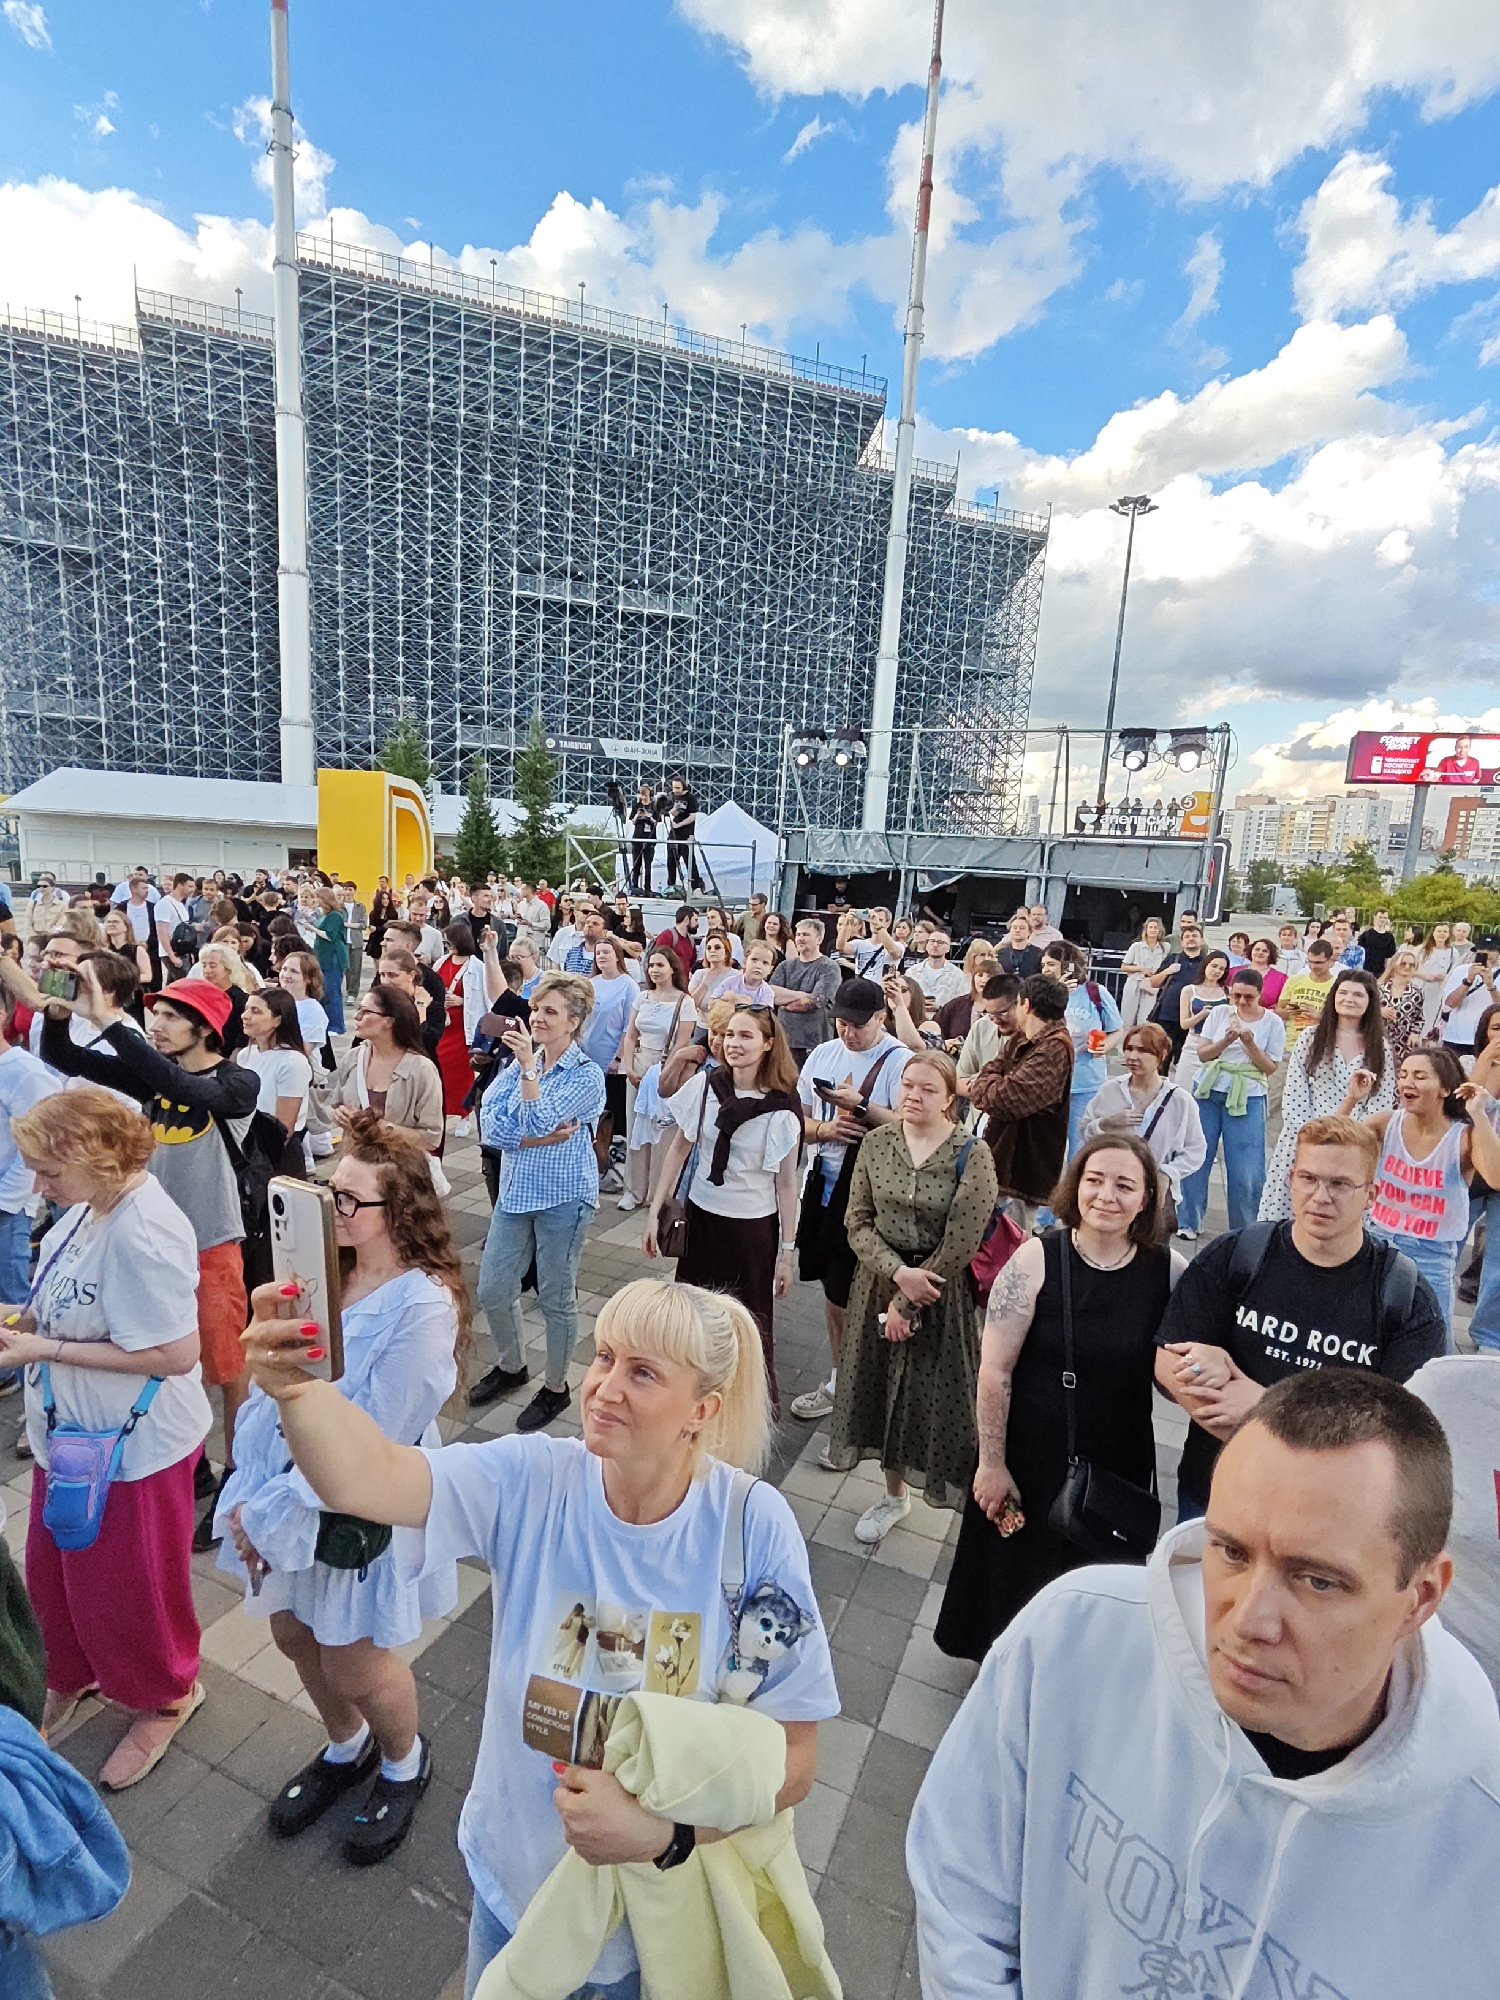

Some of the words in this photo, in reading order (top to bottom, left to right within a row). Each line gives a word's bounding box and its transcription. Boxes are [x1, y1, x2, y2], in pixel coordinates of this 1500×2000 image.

[624, 746, 658, 756] ФАН-ЗОНА
[1384, 1154, 1445, 1189] BELIEVE
[1376, 1178, 1406, 1204] YOU
[1410, 1193, 1446, 1216] CAN
[1372, 1202, 1401, 1228] AND
[1404, 1214, 1439, 1238] YOU
[1265, 1346, 1290, 1362] EST.
[1294, 1355, 1323, 1371] 1971
[1306, 1330, 1378, 1366] ROCK
[526, 1712, 571, 1732] CONSCIOUS
[527, 1700, 542, 1711] SAY
[543, 1704, 558, 1716] YES
[558, 1709, 570, 1720] TO
[526, 1721, 549, 1735] STYLE
